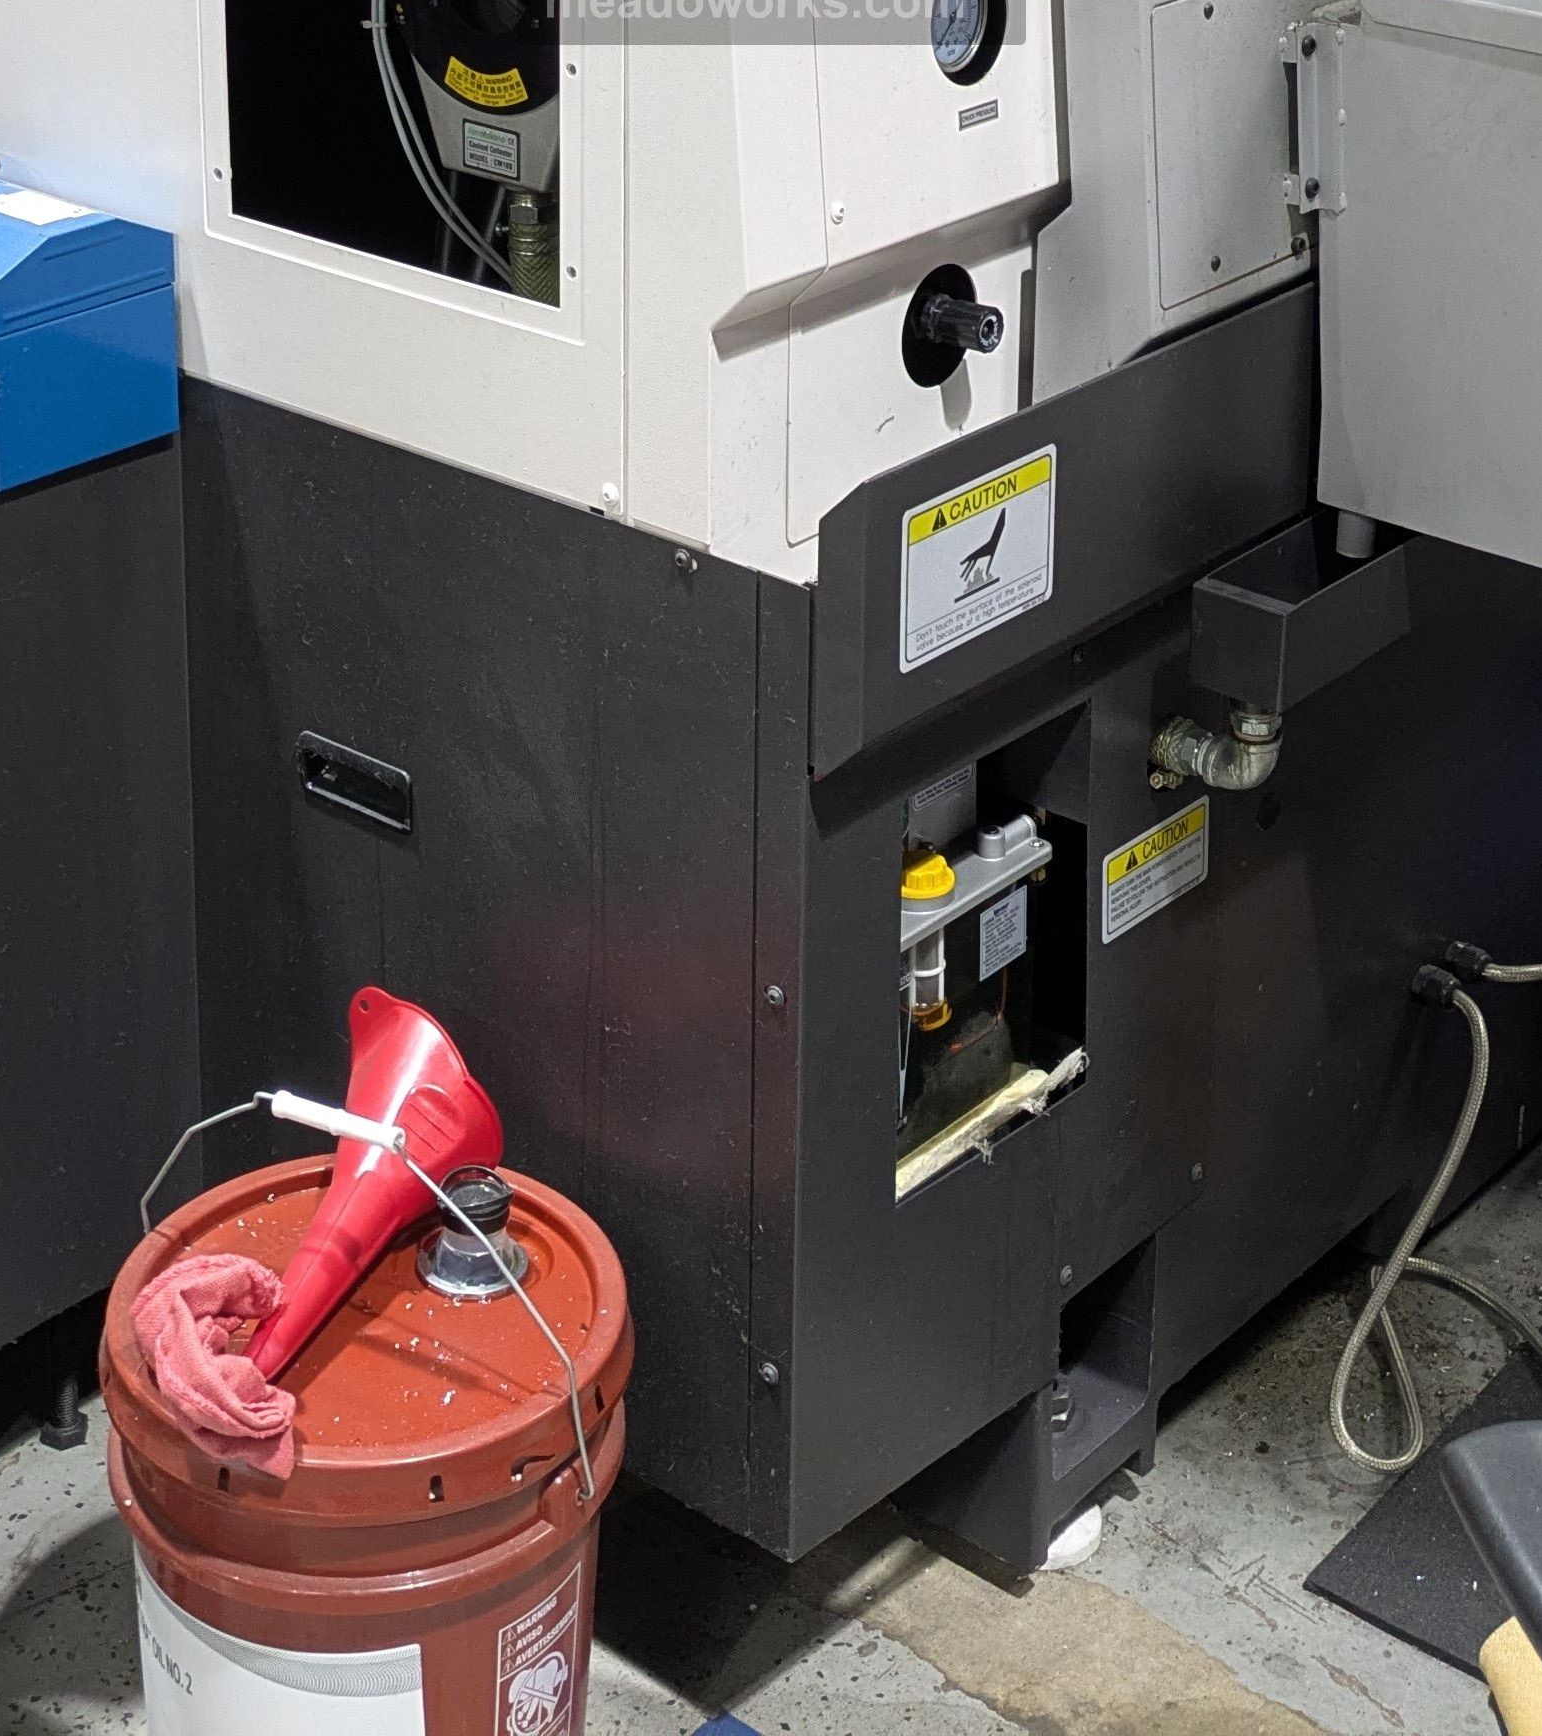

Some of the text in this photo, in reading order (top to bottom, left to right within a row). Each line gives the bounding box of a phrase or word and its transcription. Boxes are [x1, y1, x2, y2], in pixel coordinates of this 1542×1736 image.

[975, 106, 996, 119] PRESSURE
[469, 140, 513, 157] Coolant Collector
[469, 152, 487, 164] MODEL
[950, 475, 1017, 520] CAUTION
[935, 618, 954, 632] touch
[956, 611, 966, 622] the
[968, 598, 993, 615] surface
[995, 592, 1003, 603] of
[1004, 585, 1015, 597] the
[1017, 574, 1042, 592] solenoid
[916, 636, 934, 651] valve
[936, 623, 963, 642] because
[966, 617, 973, 627] of
[982, 607, 996, 619] high
[1143, 818, 1189, 859] CAUTION
[515, 1600, 578, 1666] AVERTISSEMENT
[516, 1595, 558, 1634] WARNING
[516, 1624, 543, 1651] AVISO
[166, 1654, 184, 1688] NO.
[186, 1672, 192, 1695] 2
